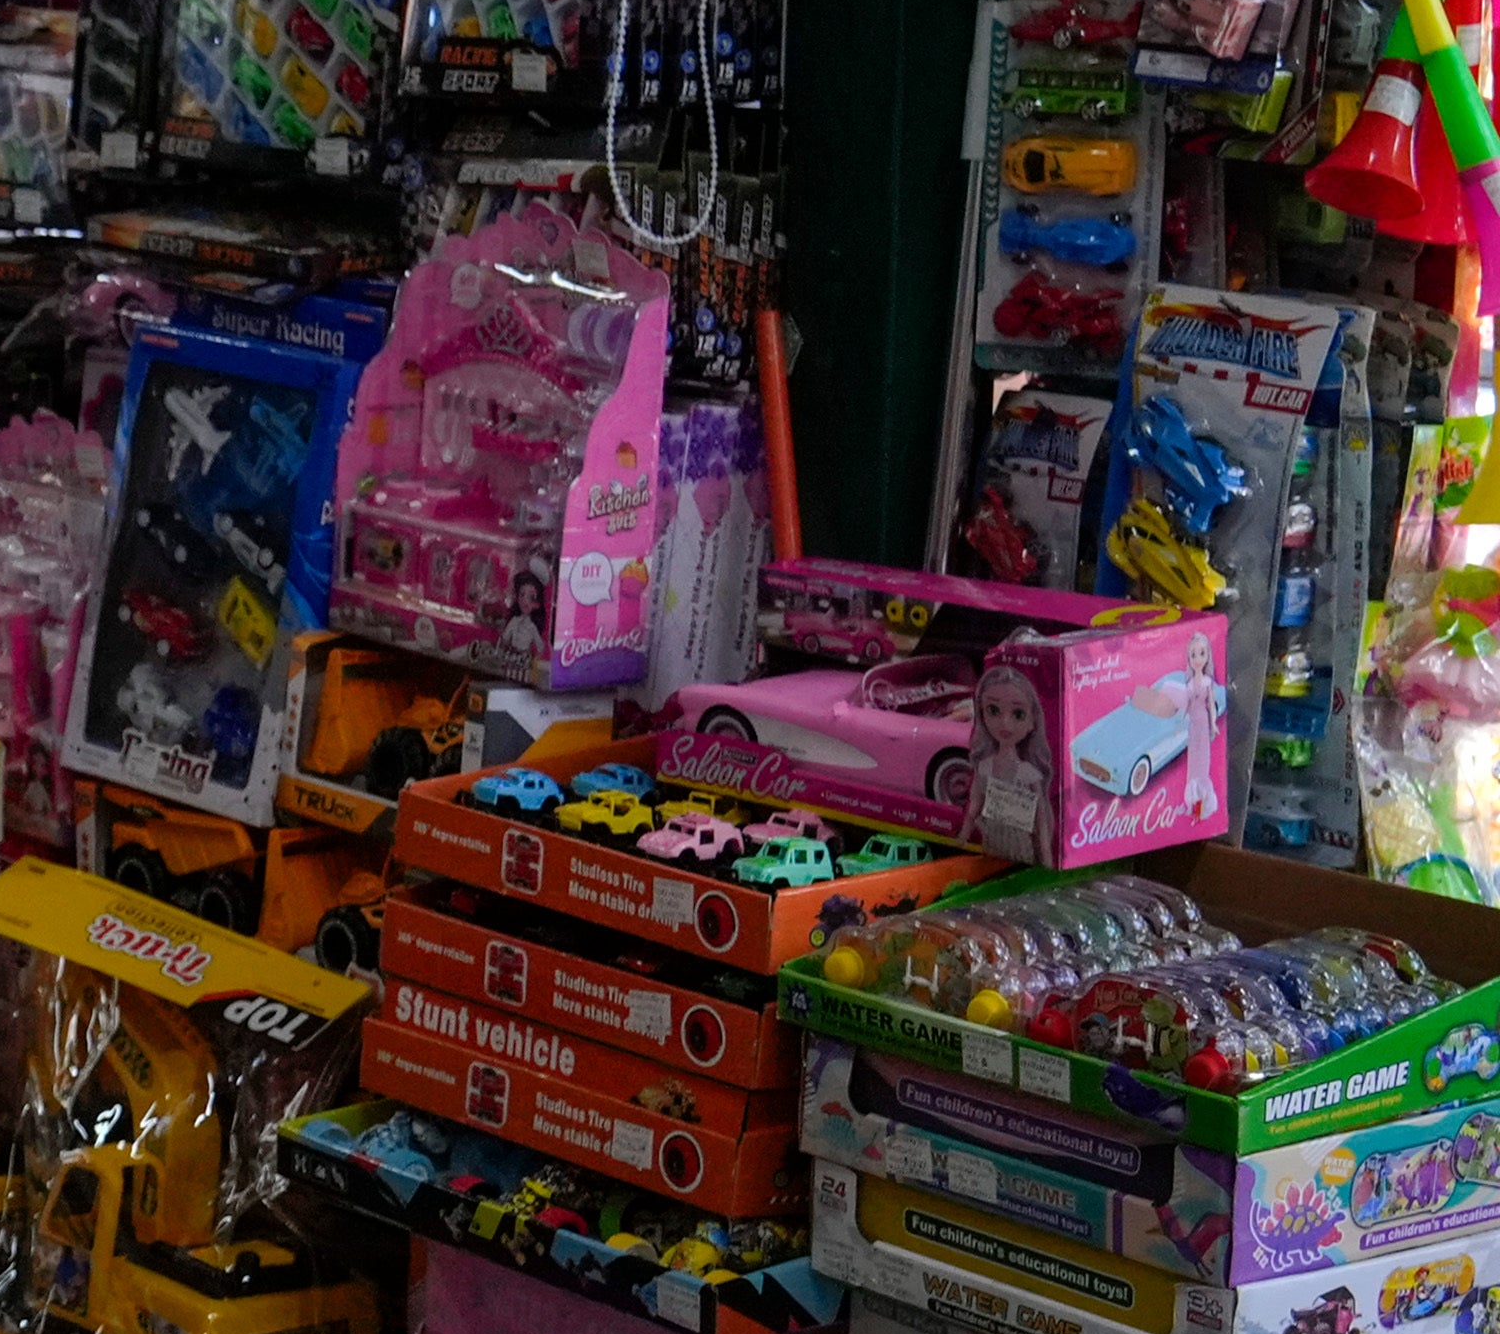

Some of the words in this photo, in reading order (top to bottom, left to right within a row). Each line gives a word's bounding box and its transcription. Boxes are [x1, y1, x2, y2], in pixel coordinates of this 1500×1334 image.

[211, 304, 271, 337] Super
[276, 314, 346, 358] Racing
[581, 564, 602, 579] DIY
[561, 624, 647, 668] Cooking
[661, 734, 746, 790] Saloon
[750, 751, 808, 802] Car
[1070, 797, 1139, 850] Saloon
[1142, 786, 1190, 835] Car
[569, 856, 621, 890] Studless
[622, 871, 647, 896] Tire
[568, 880, 598, 905] More
[599, 889, 636, 917] stable
[88, 913, 212, 987] Truck
[554, 968, 605, 1000] Studless
[223, 996, 311, 1044] TOP
[396, 984, 471, 1042] Stunt
[474, 1016, 576, 1077] vehicle
[552, 991, 582, 1018] More
[583, 1003, 621, 1030] stable
[818, 994, 894, 1033] WATER
[900, 1020, 963, 1053] GAME
[534, 1091, 586, 1124] Studless
[587, 1106, 613, 1131] Tire
[1264, 1077, 1344, 1123] WATER
[1345, 1059, 1411, 1099] GAME
[532, 1113, 562, 1138] More
[563, 1126, 602, 1152] stable
[904, 1083, 933, 1108] Fun
[934, 1097, 1004, 1135] children's
[1006, 1117, 1096, 1156] educational
[1097, 1141, 1136, 1170] toys!
[820, 1175, 847, 1198] 24
[1011, 1173, 1077, 1211] GAME
[1364, 1229, 1385, 1247] Fun
[1387, 1215, 1440, 1244] children's
[911, 1214, 937, 1238] Fun
[938, 1225, 1004, 1259] children's
[1007, 1246, 1091, 1288] educational
[1092, 1274, 1130, 1303] toys!
[922, 1272, 1009, 1313] WATER
[934, 1300, 952, 1315] Fun
[1186, 1288, 1224, 1316] 3+
